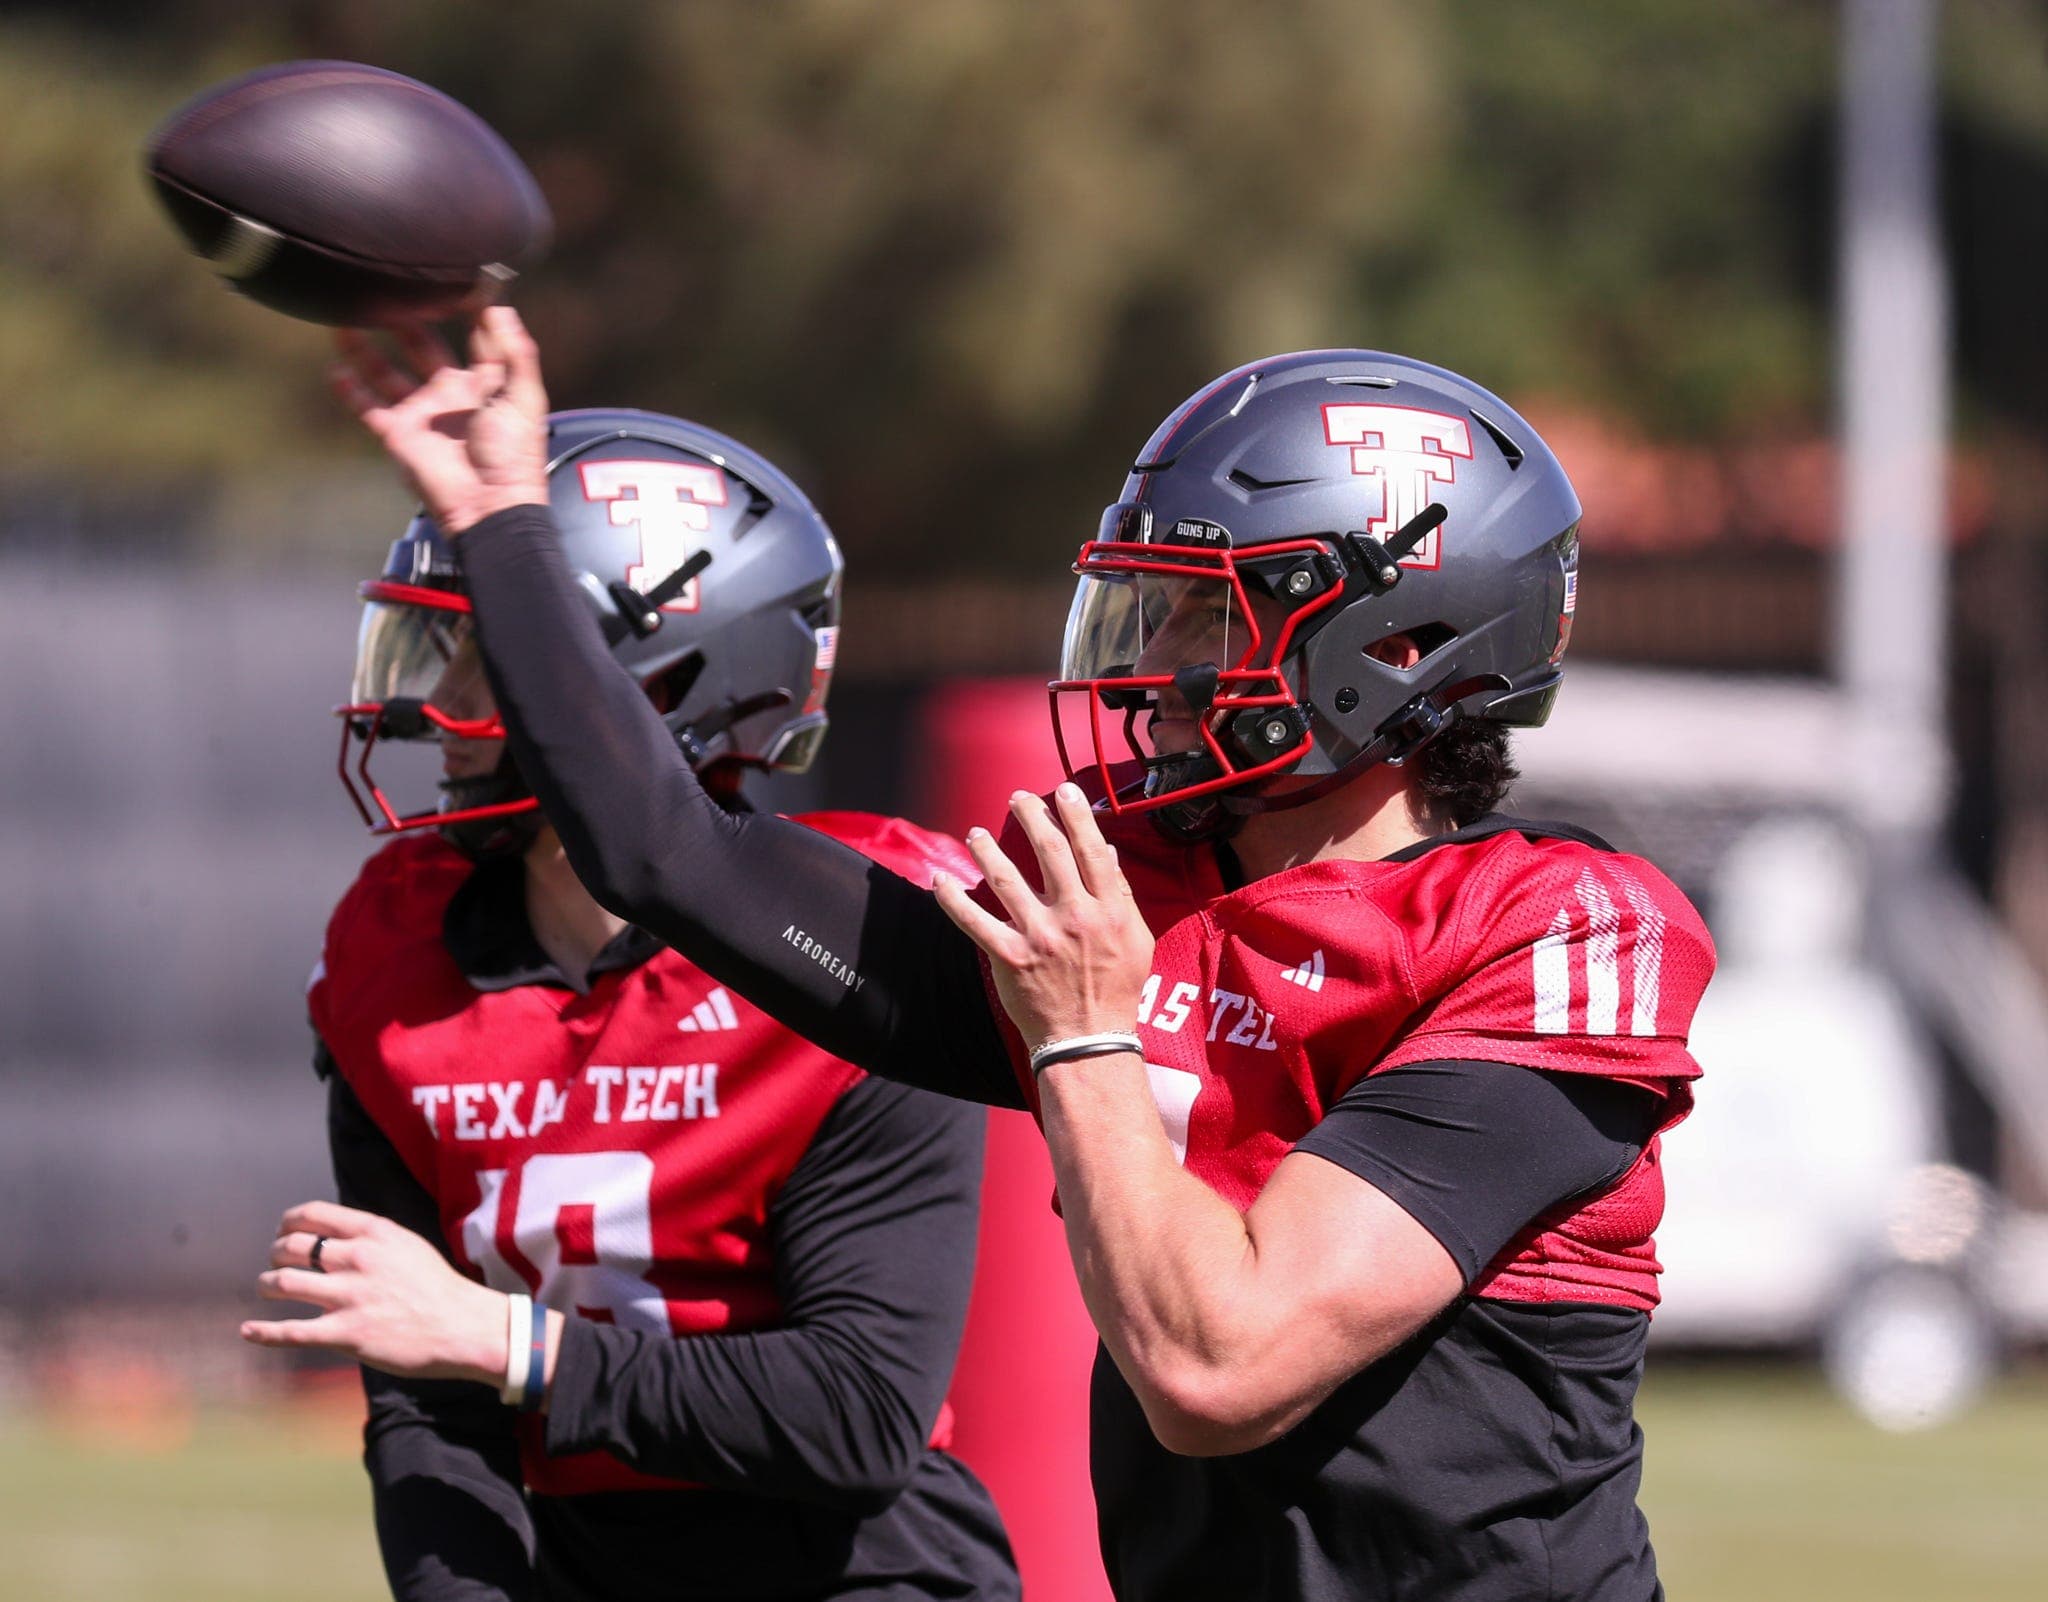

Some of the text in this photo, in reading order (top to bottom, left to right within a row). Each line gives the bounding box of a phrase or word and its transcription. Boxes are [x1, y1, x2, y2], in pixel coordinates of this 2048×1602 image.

[1176, 522, 1221, 540] GUNS UP
[782, 925, 866, 993] AEROREADY
[586, 1063, 721, 1124] TECH
